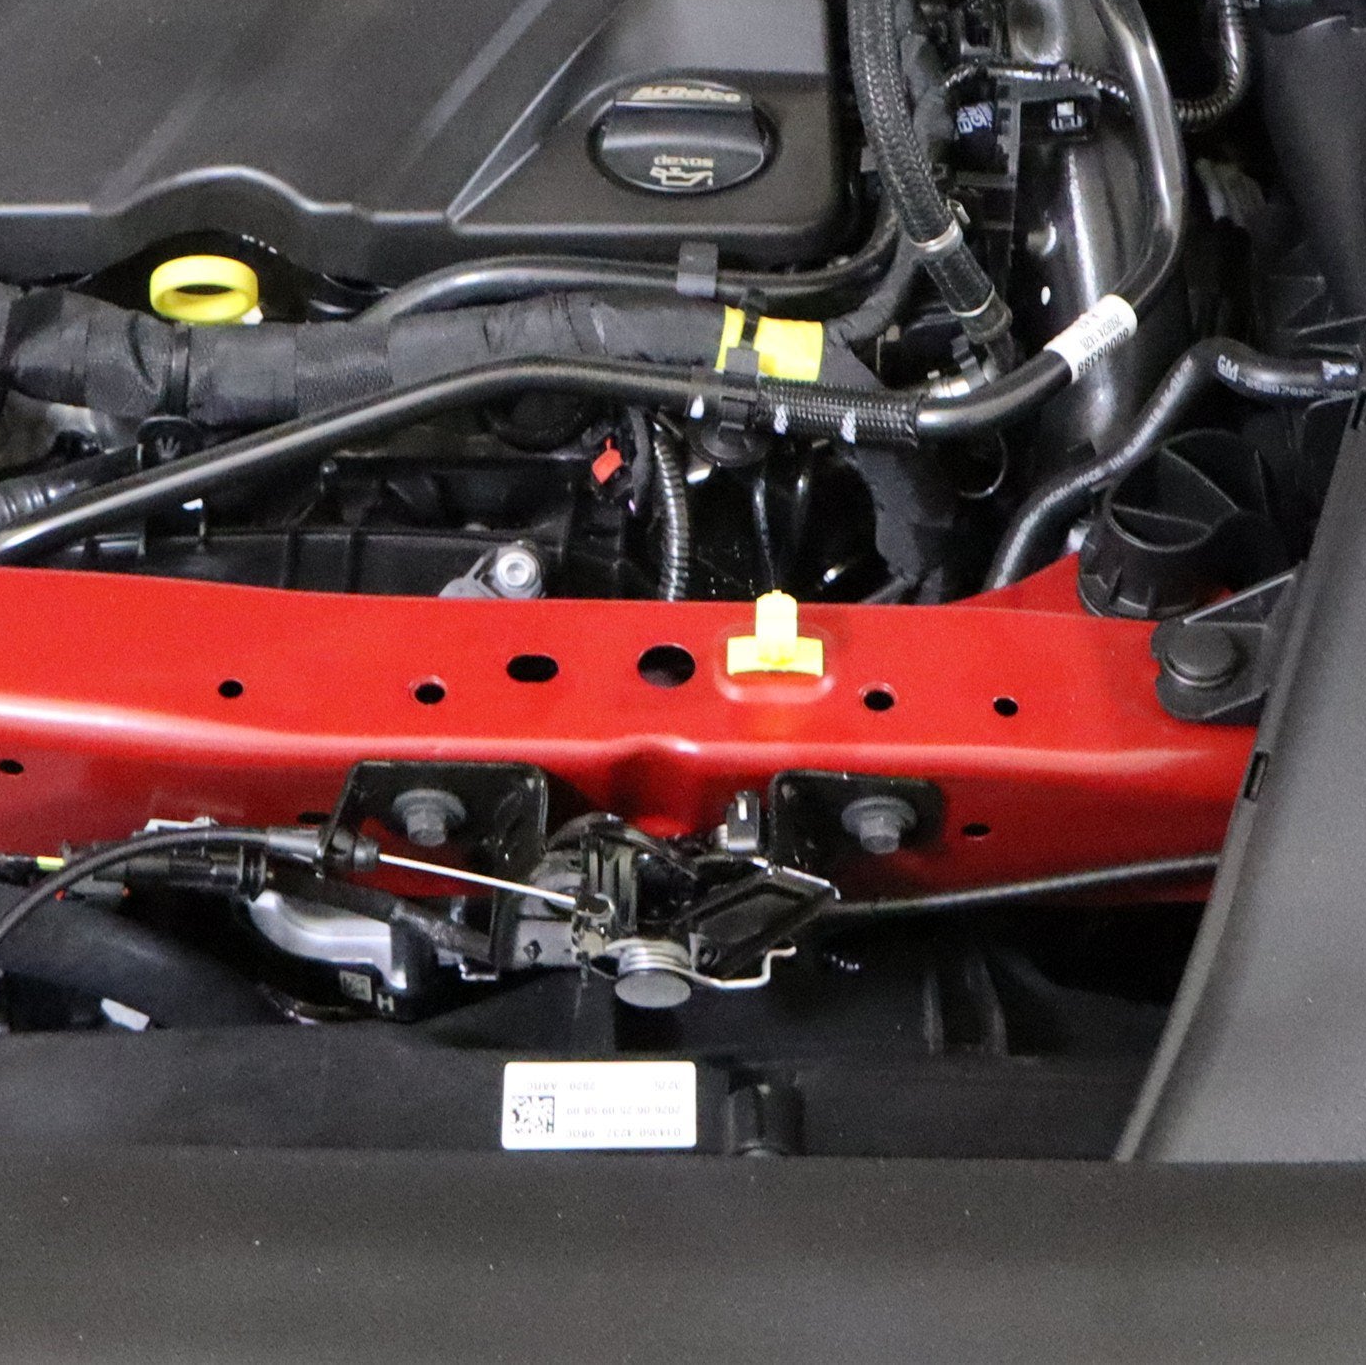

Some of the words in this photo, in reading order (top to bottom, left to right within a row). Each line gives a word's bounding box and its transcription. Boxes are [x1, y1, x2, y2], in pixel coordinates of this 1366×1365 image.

[631, 86, 741, 103] ACDelco
[654, 153, 714, 168] dexos
[1217, 354, 1240, 383] GM
